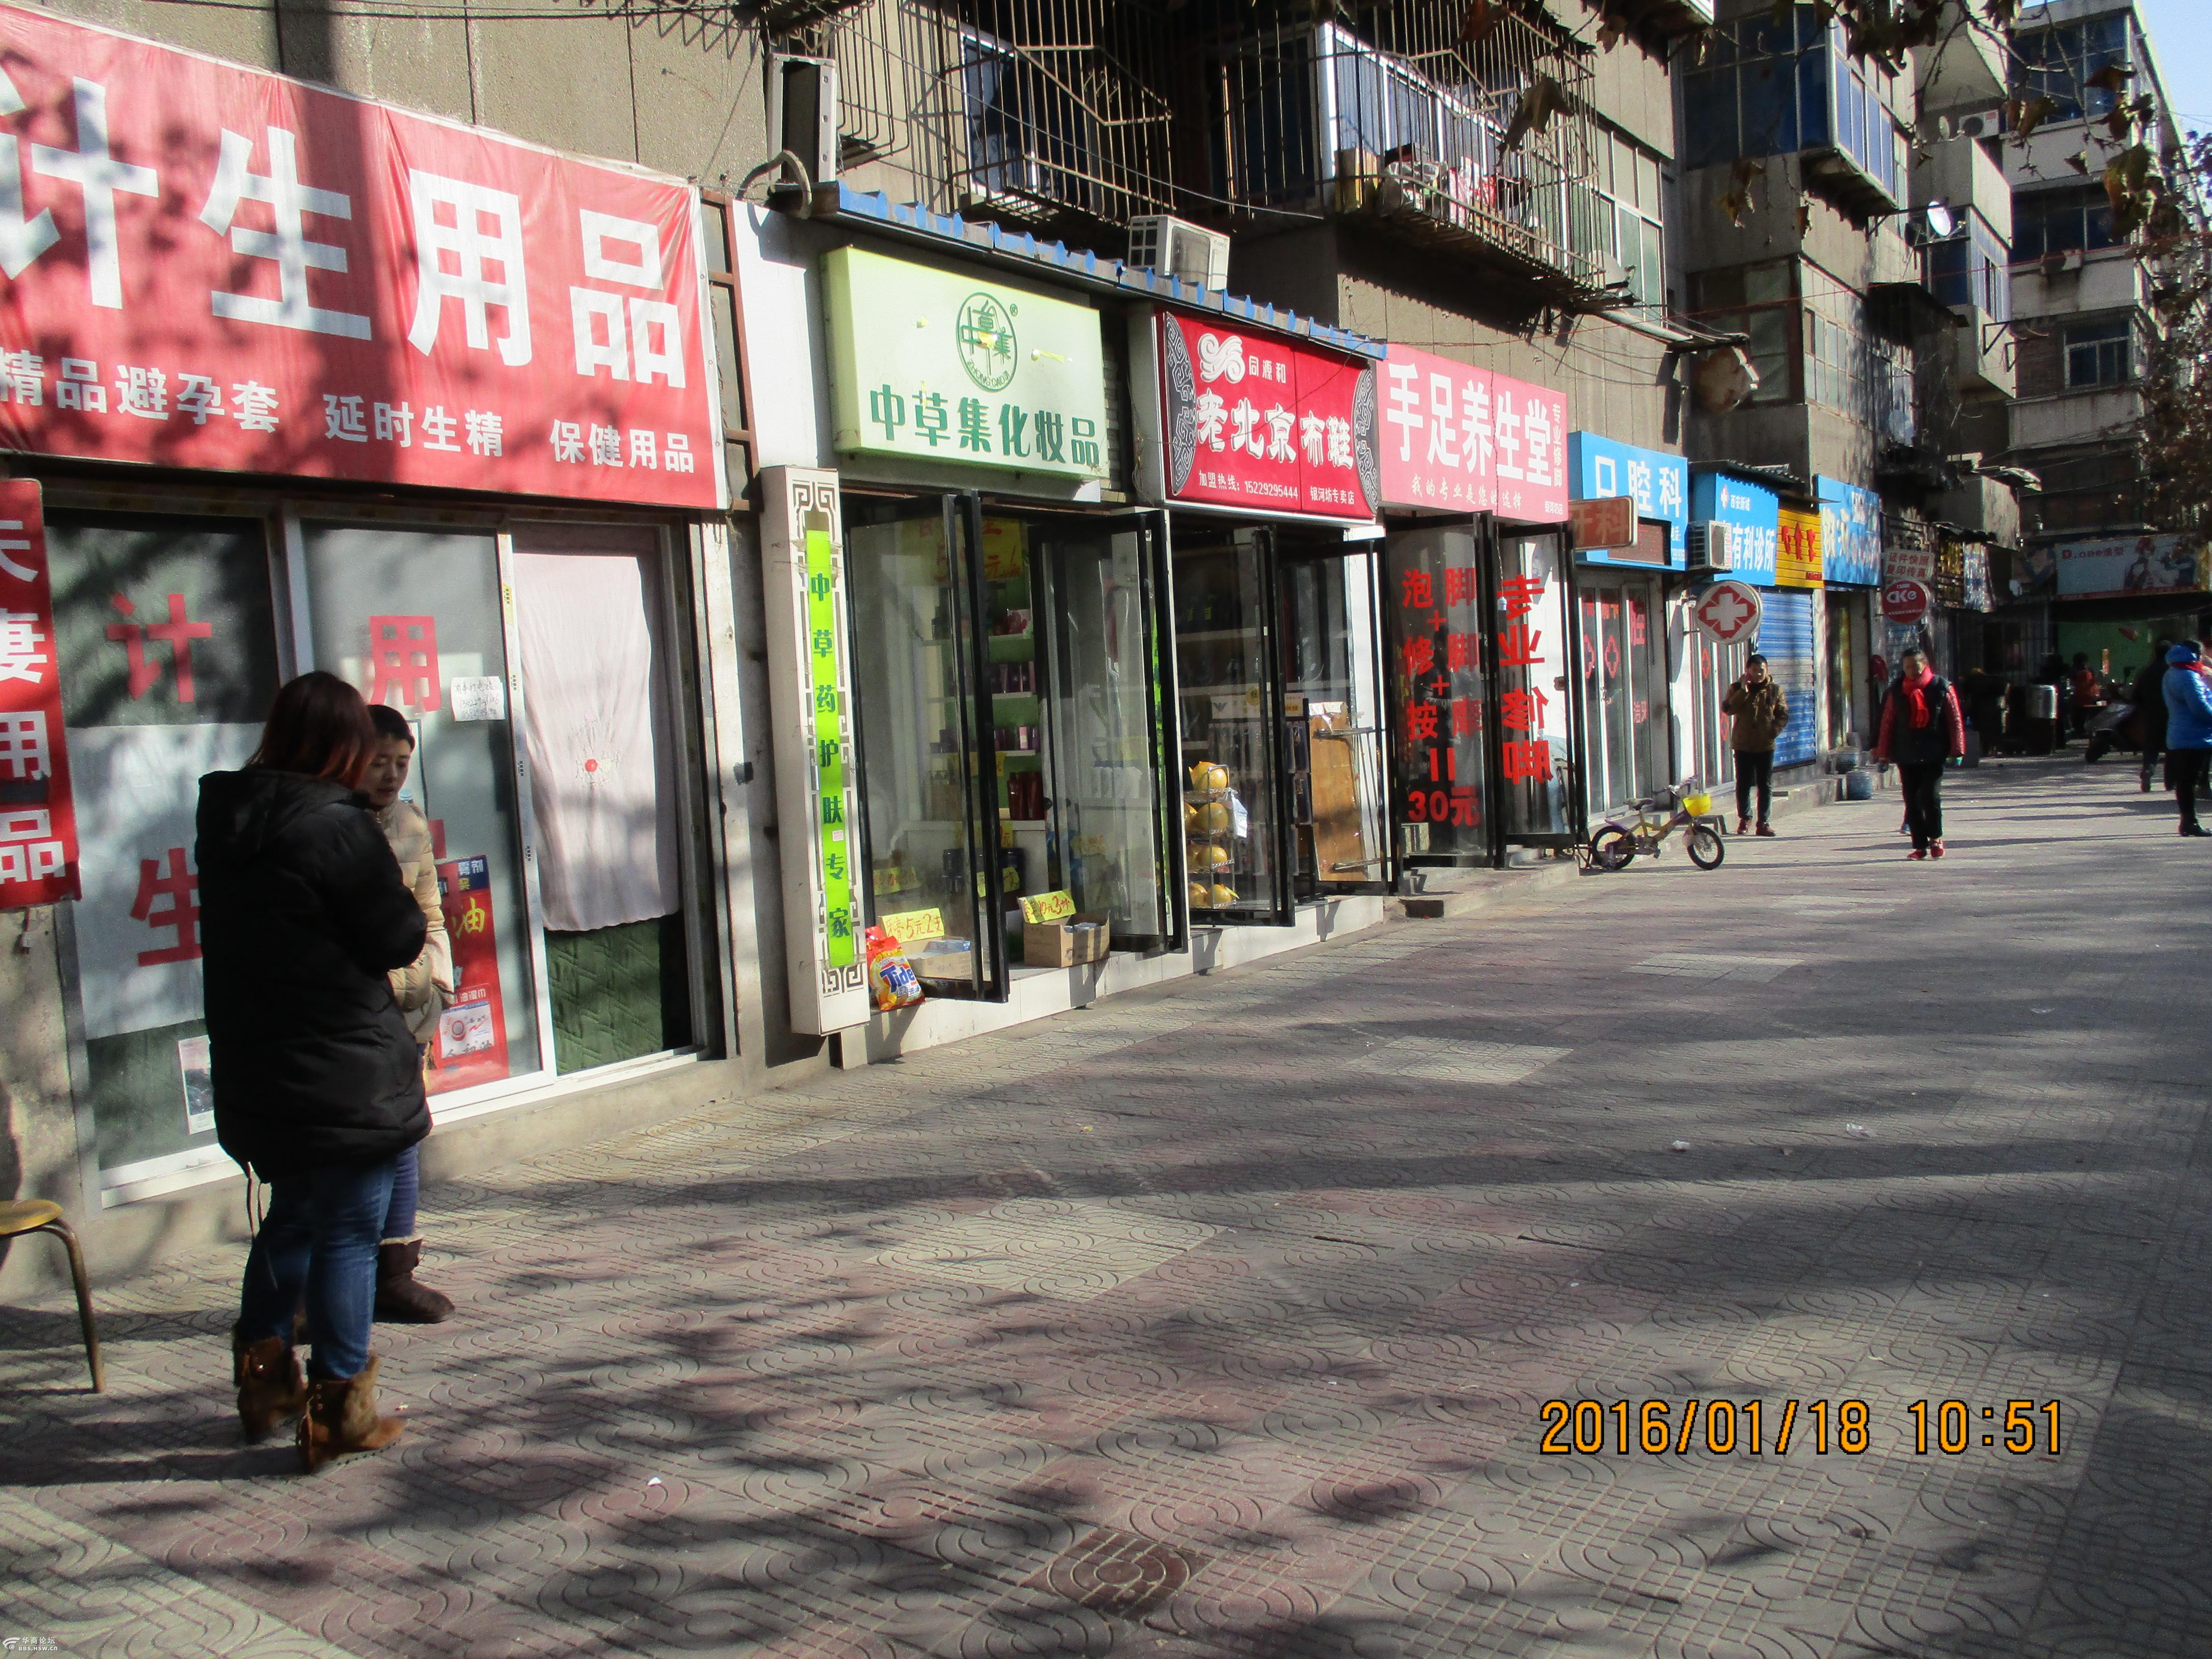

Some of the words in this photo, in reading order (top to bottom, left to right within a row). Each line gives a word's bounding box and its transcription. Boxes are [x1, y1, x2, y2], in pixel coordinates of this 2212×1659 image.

[0, 64, 686, 389] 计生用品
[0, 346, 280, 433] 精品避孕套
[1249, 355, 1286, 384] 同源和
[324, 393, 504, 458] 延时生精
[550, 419, 695, 474] 保健用品
[870, 384, 1099, 466] 中草集化妆品
[1197, 388, 1354, 470] 老北京布鞋
[1387, 363, 1552, 486] 手足养生堂
[1552, 403, 1563, 488] 专业修脚
[1310, 487, 1355, 505] 银河坊专卖店
[1412, 474, 1522, 511] 我的专业是您的选择
[1595, 455, 1682, 518] 口腔科
[1723, 520, 1775, 572] 有利诊所
[1402, 567, 1477, 608] 泡脚
[1402, 633, 1479, 676] 修脚
[1406, 696, 1483, 741] 按摩
[810, 572, 851, 938] 中草药护肤专家
[1408, 786, 1481, 826] 30元
[886, 913, 943, 942] 牙膏5元2支
[879, 965, 915, 993] Tide
